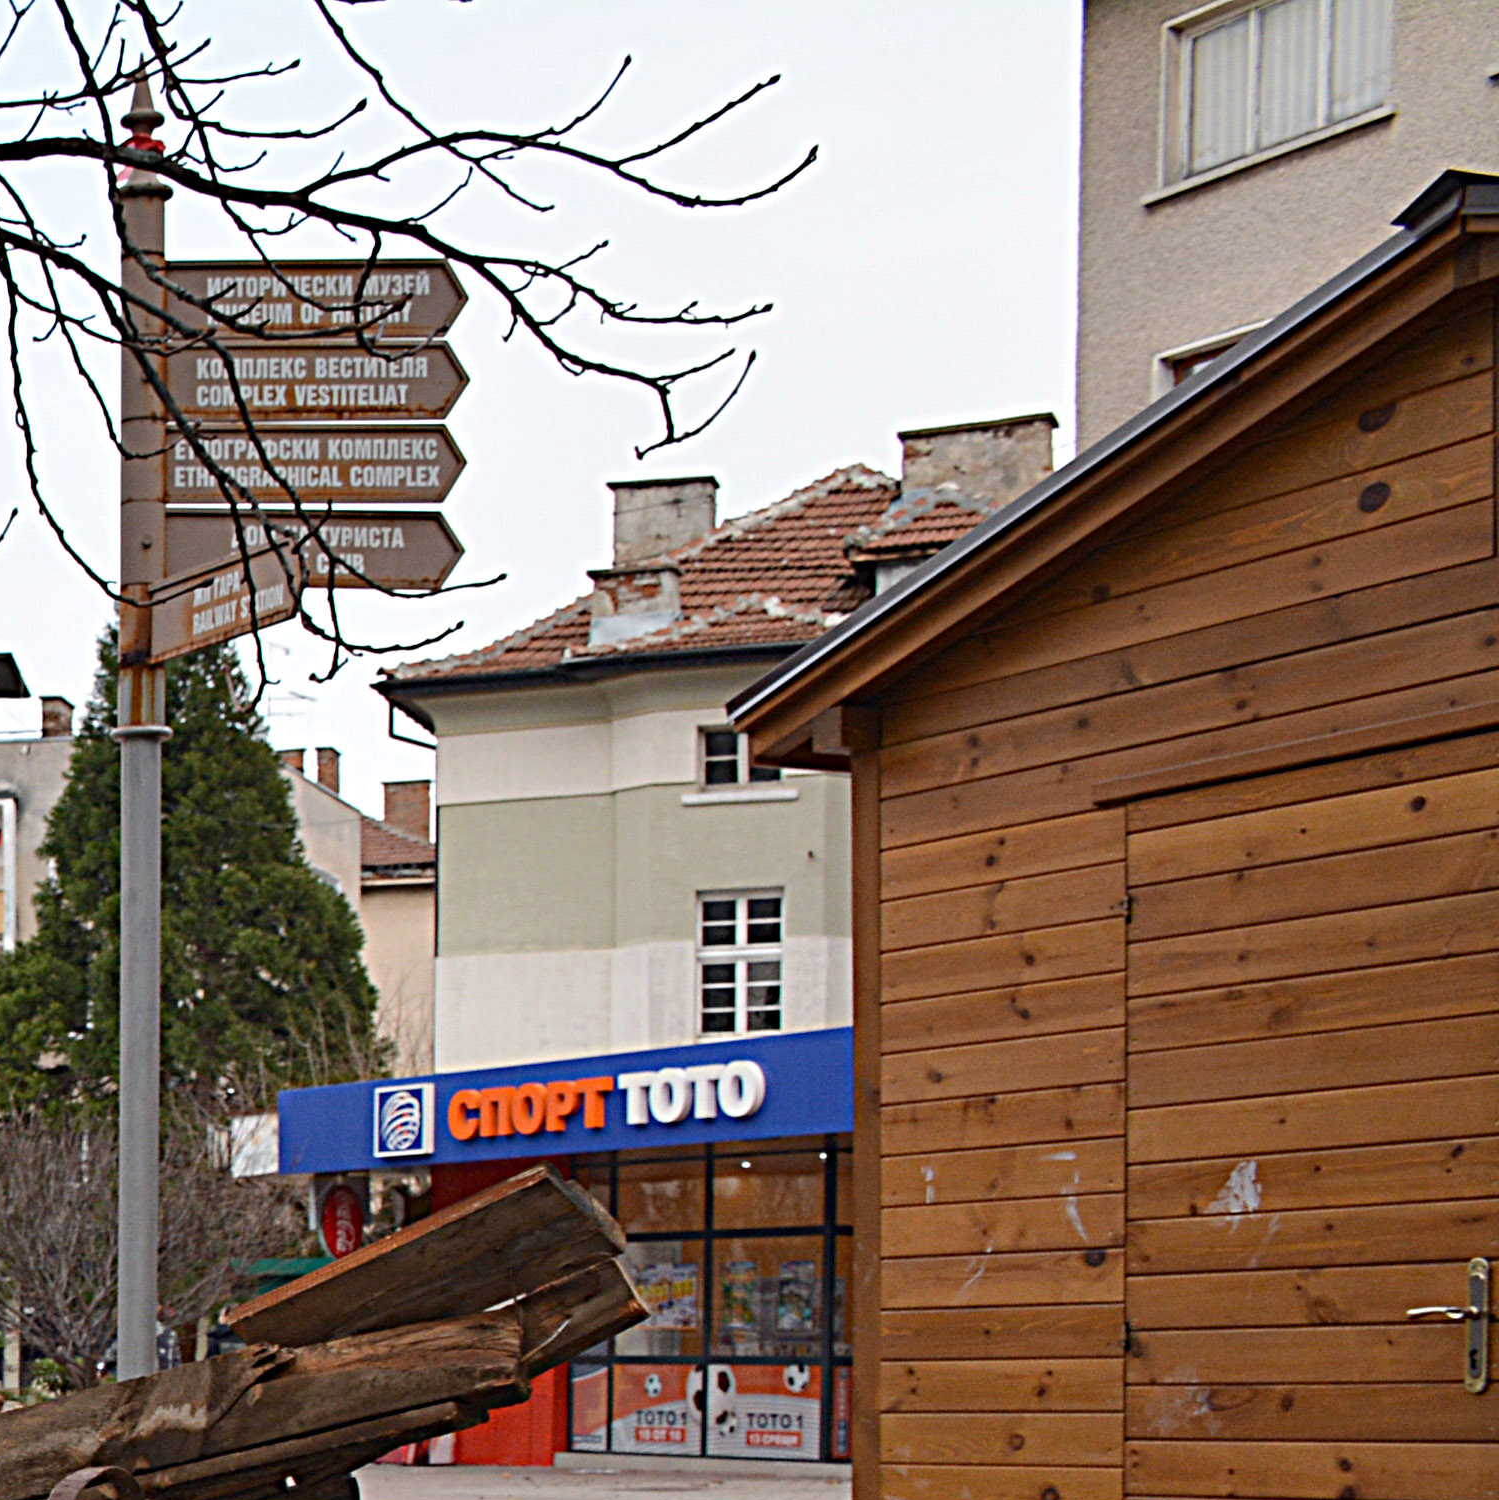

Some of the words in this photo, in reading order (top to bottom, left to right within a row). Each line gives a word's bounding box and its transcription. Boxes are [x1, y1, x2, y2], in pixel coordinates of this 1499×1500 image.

[207, 276, 353, 298] ИСТОРИЧЕСКИ
[364, 271, 430, 295] МУЗЕЙ
[315, 357, 428, 379] ВЕСТИТЕЛЯ
[196, 384, 287, 407] COMPLEX
[294, 384, 408, 407] VESTITELIAT
[328, 439, 438, 460] КОМПЛЕКС
[350, 467, 440, 488] COMPLEX
[320, 527, 404, 548] ТУРИСТА
[213, 570, 241, 600] ГАРА
[448, 1076, 614, 1140] СПОРТ
[618, 1060, 766, 1126] ТОТО
